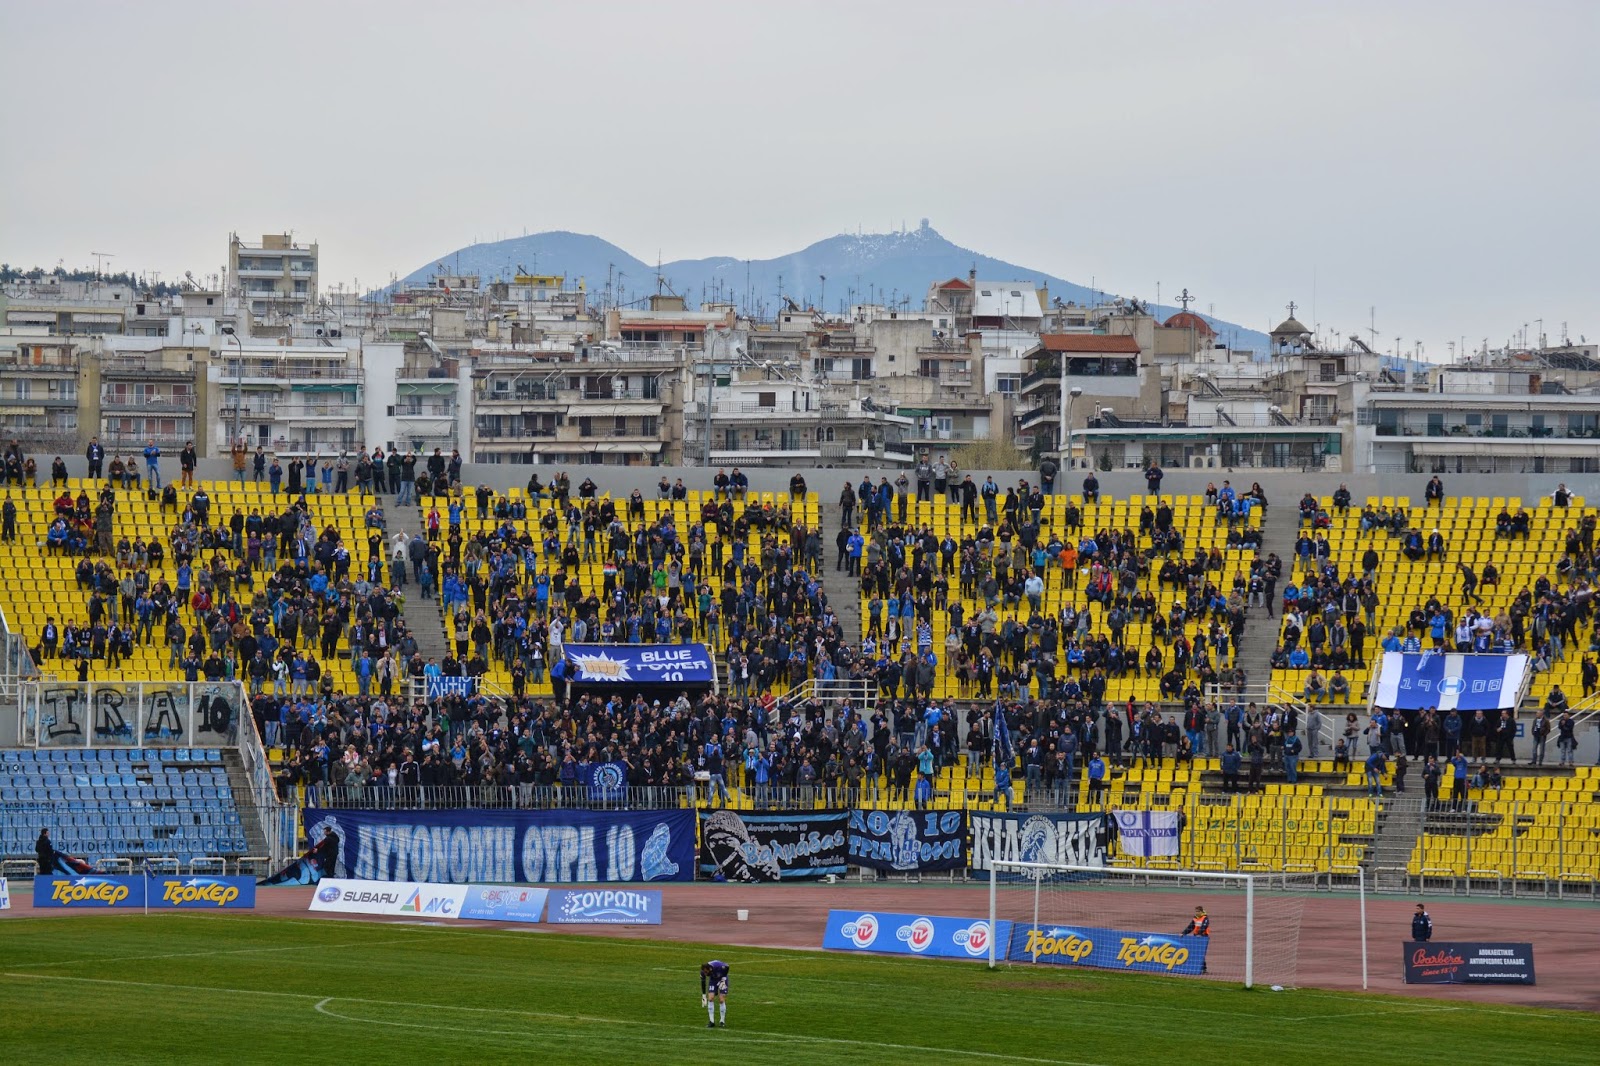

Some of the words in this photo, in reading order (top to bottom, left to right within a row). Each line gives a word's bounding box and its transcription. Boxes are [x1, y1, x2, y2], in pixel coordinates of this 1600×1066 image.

[641, 650, 692, 662] BLUE
[661, 672, 683, 682] 10
[197, 694, 231, 734] 10
[924, 811, 961, 837] 10
[522, 824, 598, 883] ΘΥΡΑ
[605, 824, 636, 882] 10
[343, 891, 399, 904] SUBARU
[569, 890, 648, 915] ΣΟΥΡΩΤΗ
[422, 897, 455, 914] AVC
[857, 925, 873, 937] TV
[912, 929, 929, 940] TV
[969, 932, 987, 944] TV
[1412, 948, 1465, 966] Barbera
